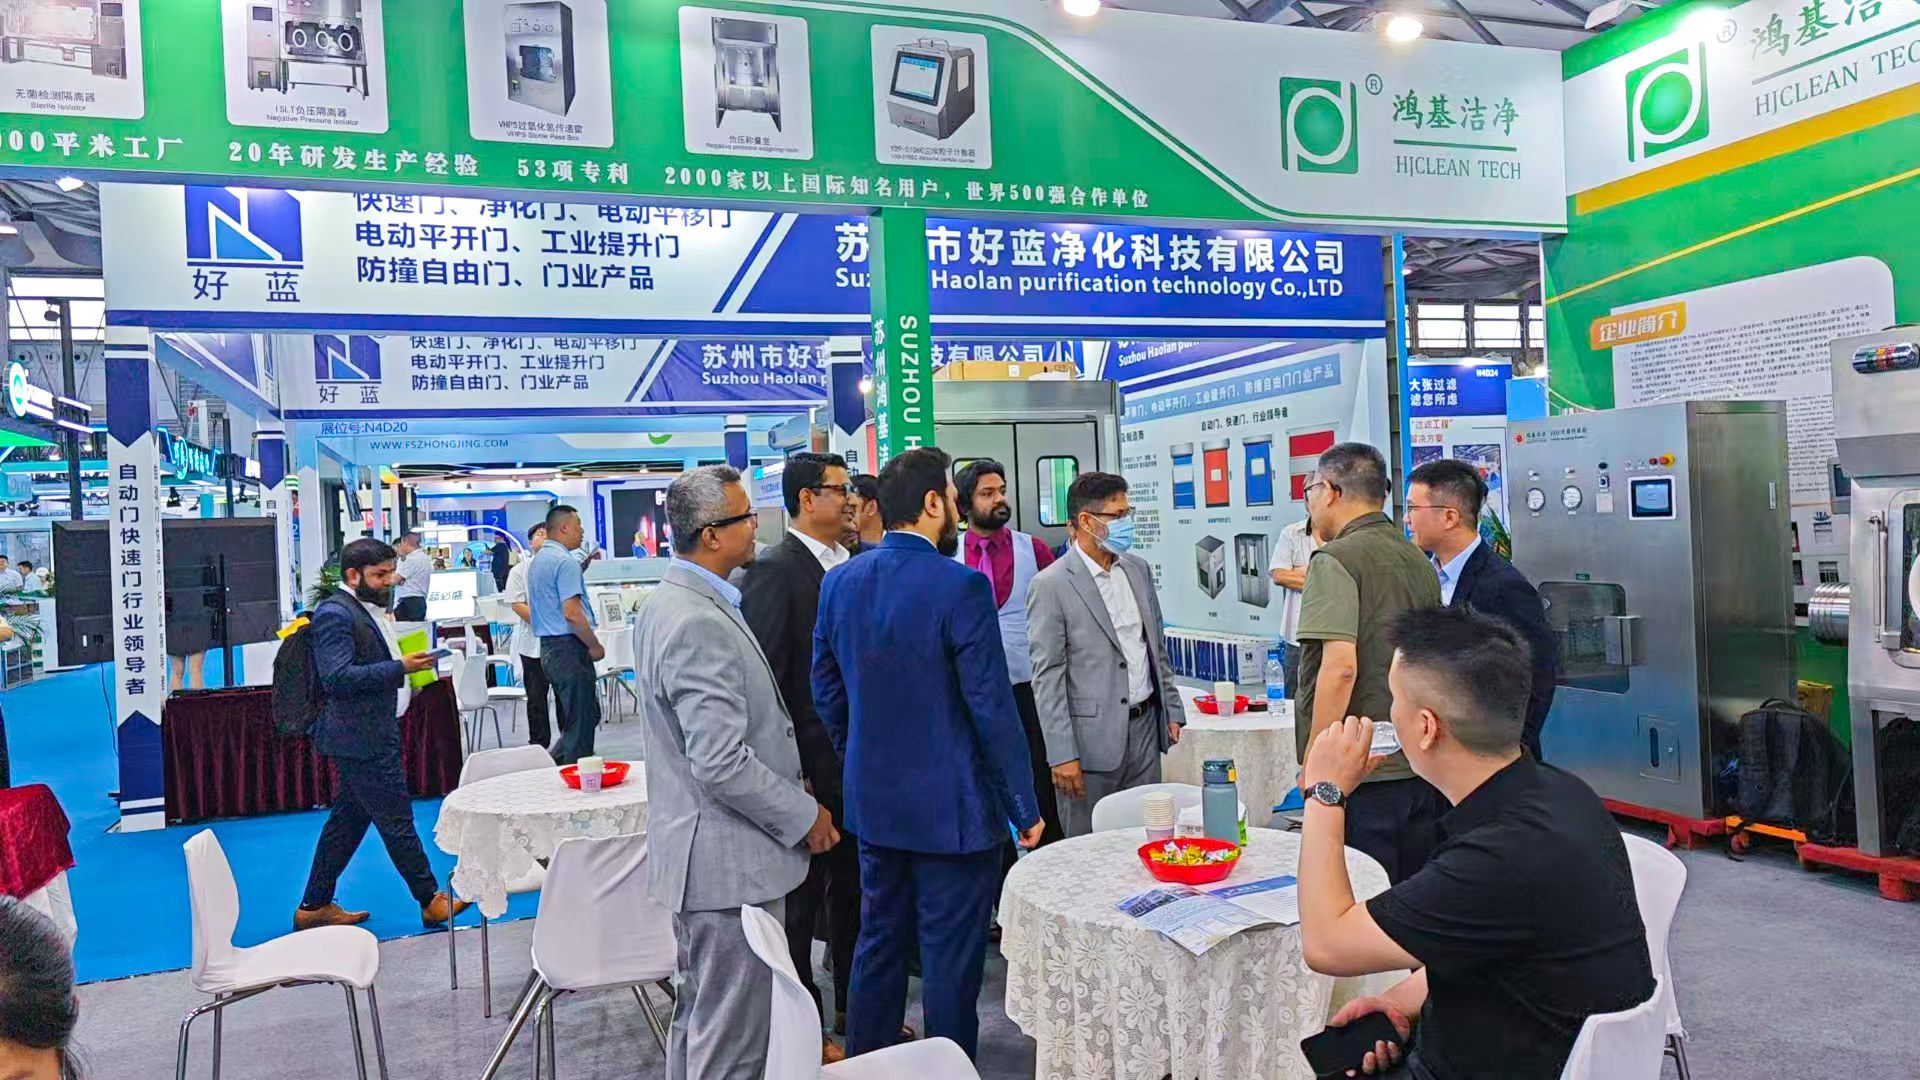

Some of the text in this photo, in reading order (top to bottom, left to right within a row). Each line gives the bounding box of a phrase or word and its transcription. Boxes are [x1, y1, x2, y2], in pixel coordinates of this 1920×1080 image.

[1751, 0, 1884, 60] 鸿基洁
[1755, 40, 1920, 116] HJCLEAN TEC
[1392, 88, 1519, 136] 鸿基洁净
[0, 130, 184, 161] 00平米工厂
[229, 142, 480, 177] 20年研发生产经验
[517, 158, 631, 185] 53项专利
[1396, 155, 1521, 179] HJCLEAN TECH
[355, 220, 680, 259] 电动平开门、工业提升门
[835, 222, 1344, 275] 苏市好蓝净化科技有限公司
[193, 269, 301, 303] 好蓝
[357, 256, 654, 290] 防撞自由门、门业产品
[931, 270, 1343, 300] Haolan purification technology Co.,LTD
[1600, 310, 1678, 343] 企业简介
[411, 354, 605, 372] 电动平开门、工业提升门
[900, 315, 921, 423] SUZHOU
[1118, 351, 1147, 367] Suzhou
[1147, 342, 1177, 359] Haolan
[319, 385, 380, 404] 好蓝
[412, 373, 589, 392] 防撞自由门、门业产品
[701, 371, 758, 385] Suzhou
[763, 371, 817, 385] Haolan
[1409, 378, 1458, 392] 大张过滤
[370, 439, 509, 450] WWW.FSZHONGJING.COM
[118, 463, 147, 696] 自动门快速门行业领导者
